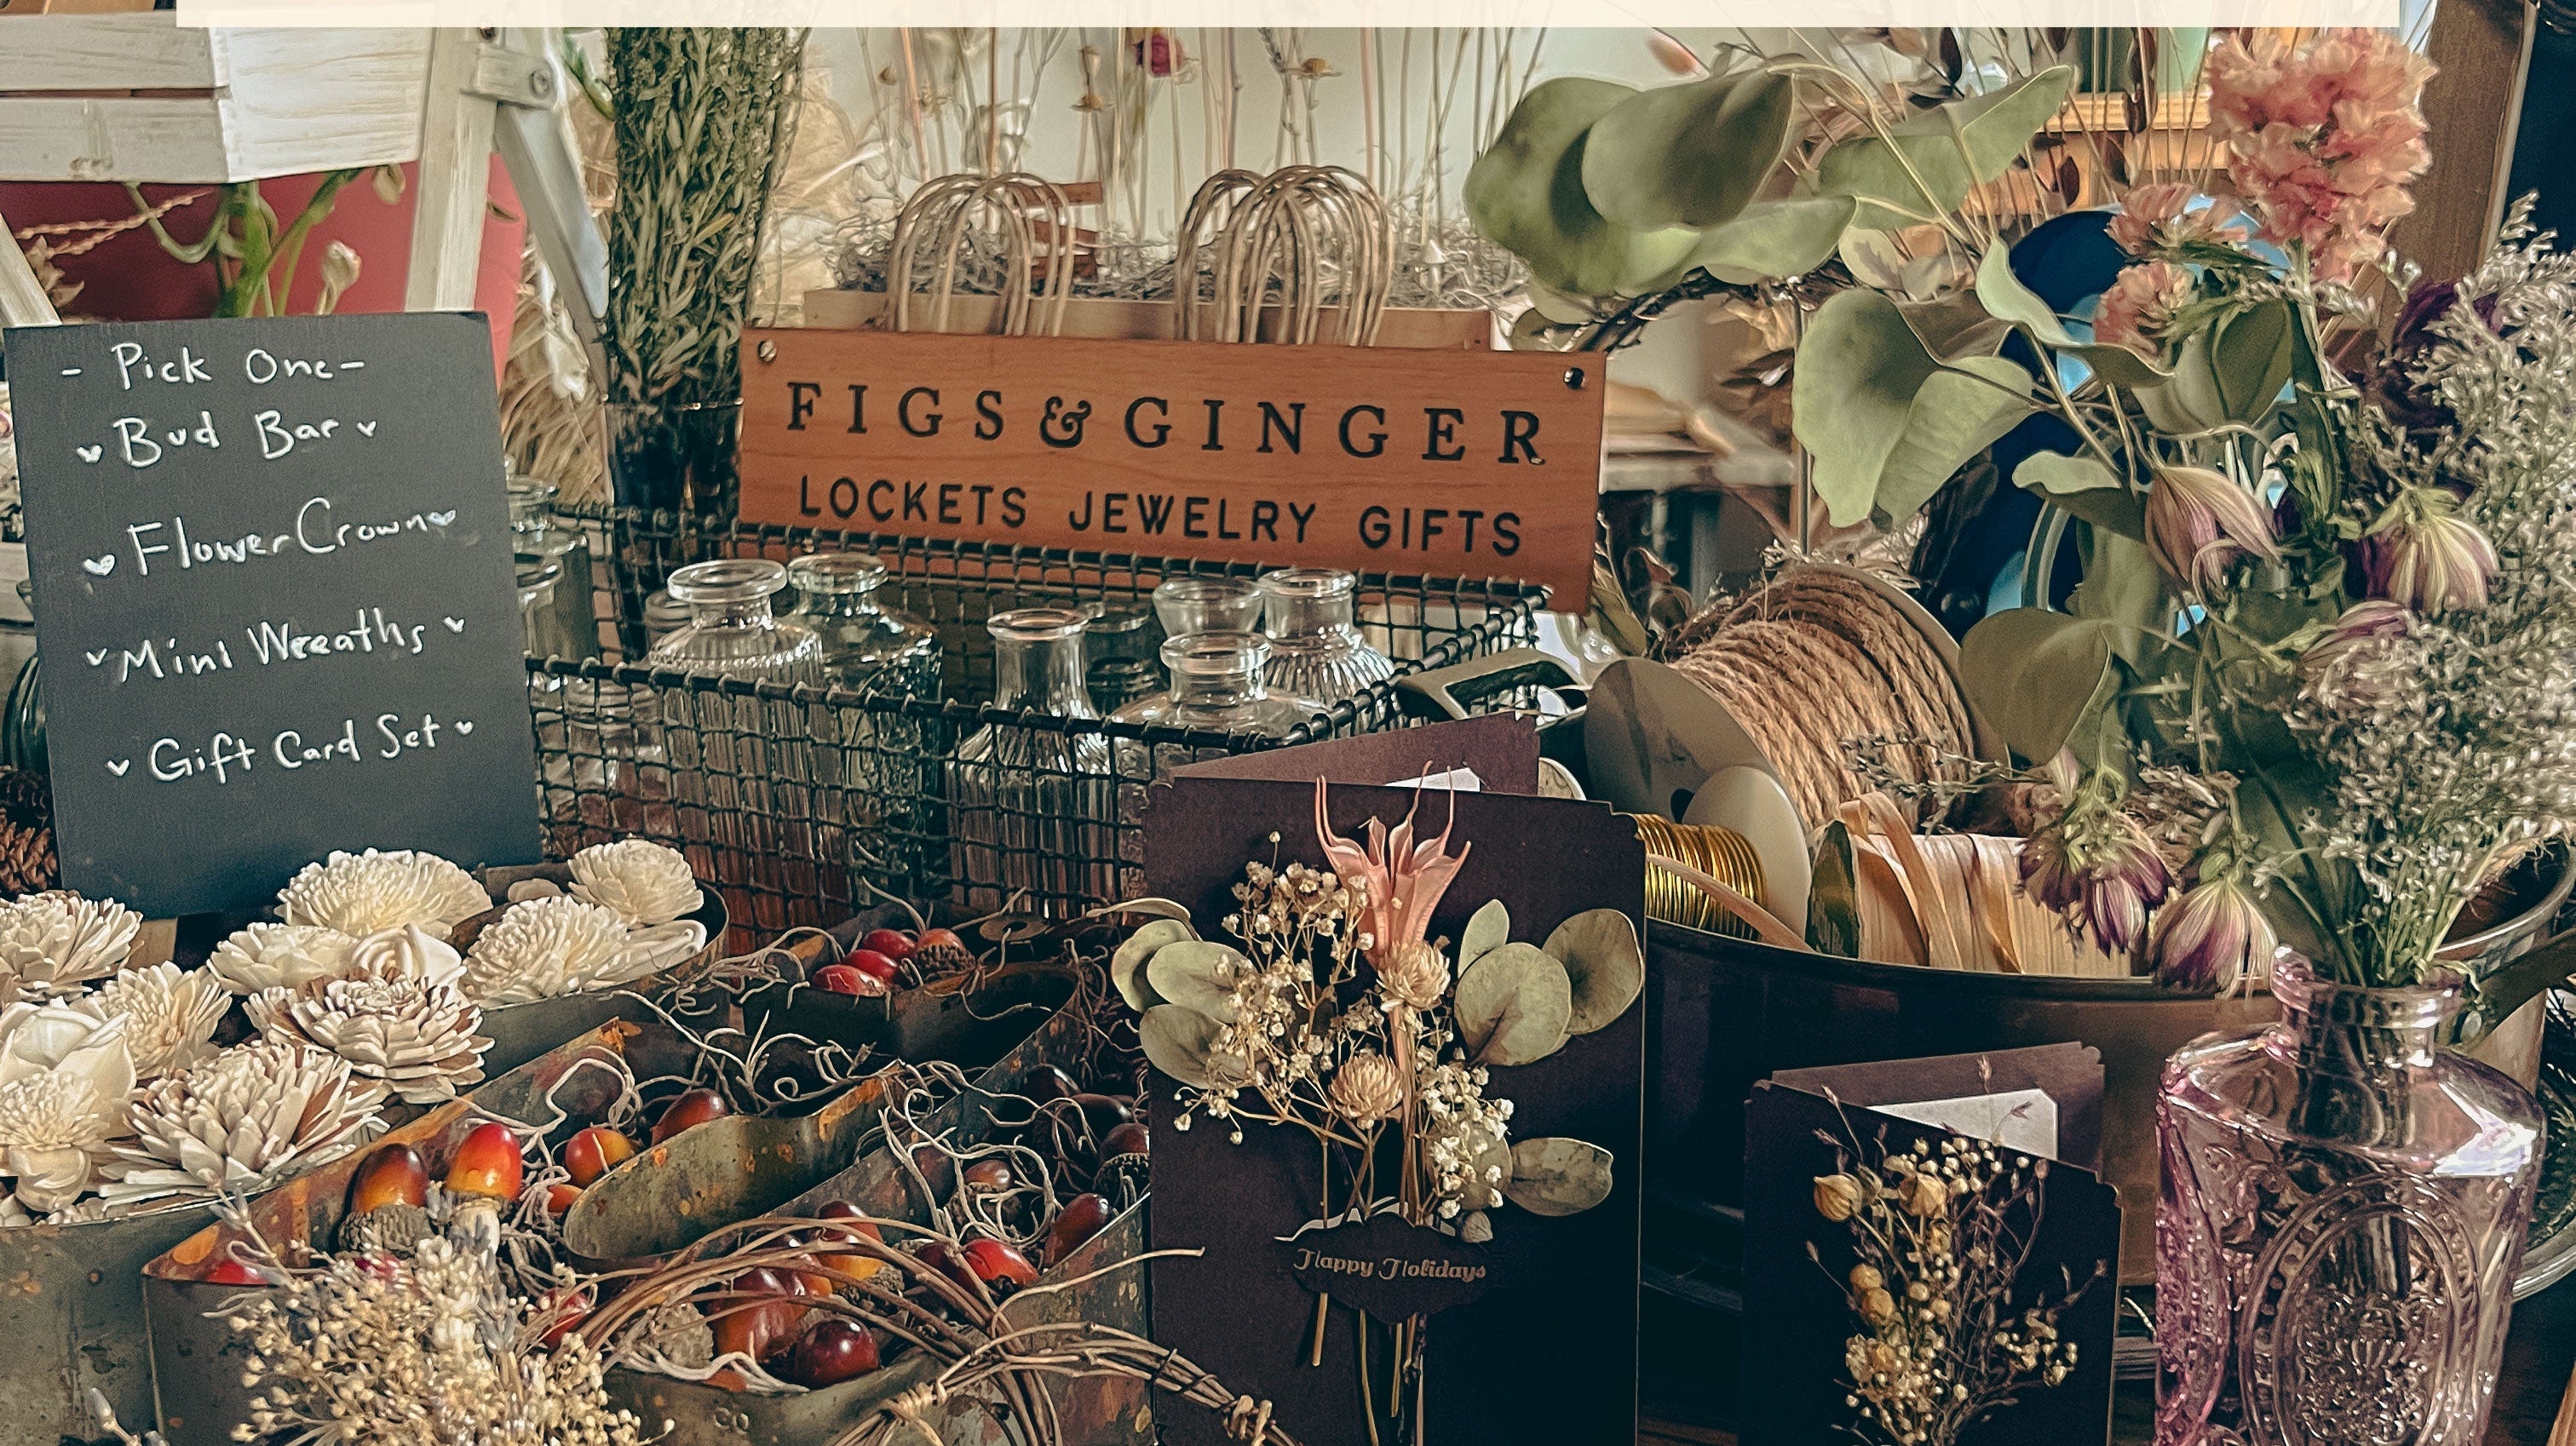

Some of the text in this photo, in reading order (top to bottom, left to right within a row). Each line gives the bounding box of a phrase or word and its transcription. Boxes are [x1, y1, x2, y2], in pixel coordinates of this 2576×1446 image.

[112, 342, 212, 390] Pick
[113, 410, 339, 468] Bud Bar
[787, 382, 1545, 466] FIGS & GINGER
[800, 475, 1521, 556] LOCKETS JEWELRY GIFTS
[120, 606, 426, 682] Mini Wreaths
[149, 714, 440, 783] Gift Card Set
[1293, 1248, 1486, 1282] Happy Holidays
